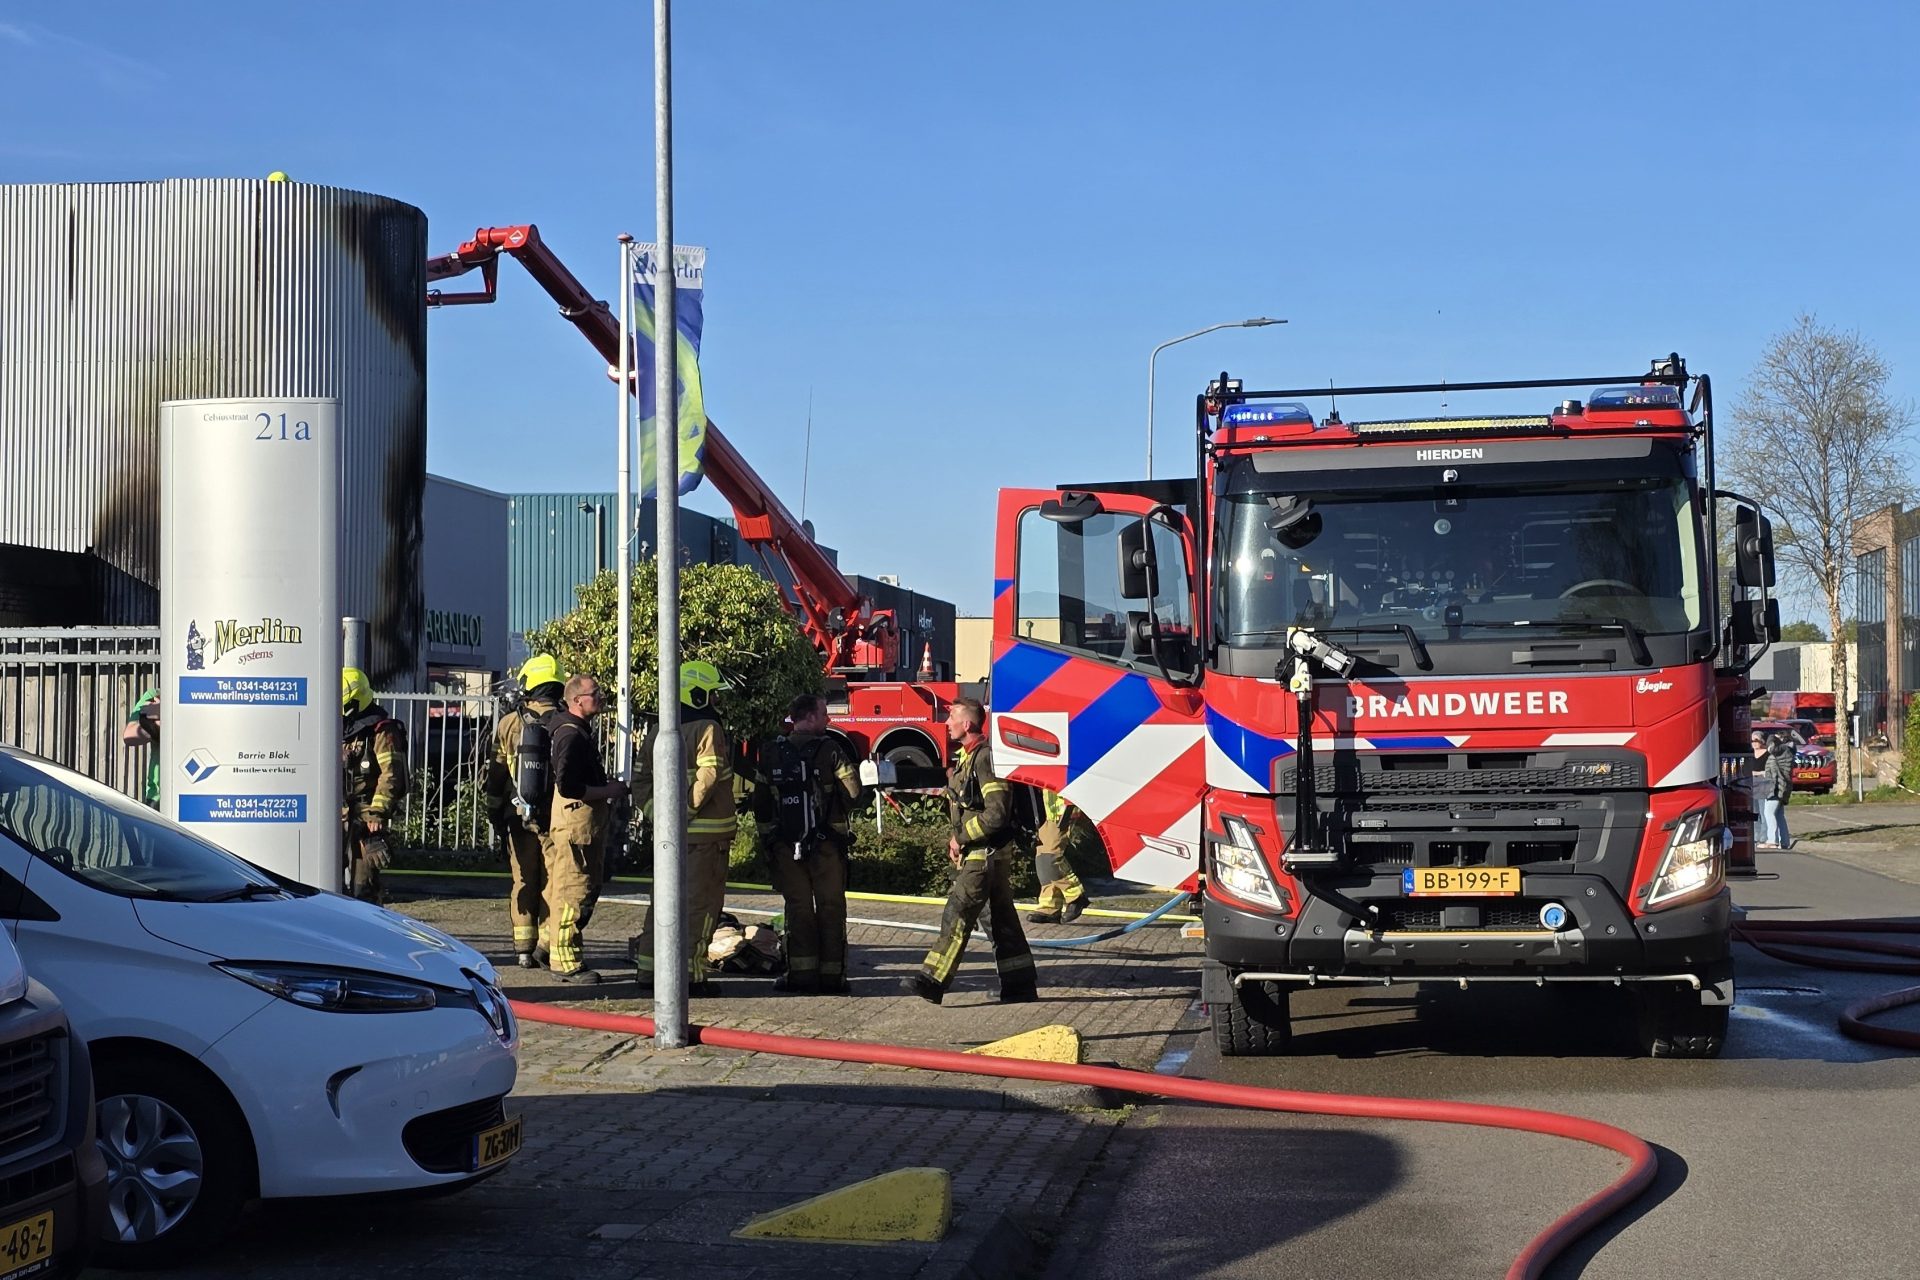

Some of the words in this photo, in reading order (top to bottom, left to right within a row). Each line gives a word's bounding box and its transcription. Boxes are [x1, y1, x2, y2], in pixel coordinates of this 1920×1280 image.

[255, 412, 312, 441] 21a
[1416, 448, 1483, 461] HIERDEN
[213, 618, 302, 664] Merlin
[238, 650, 274, 665] systems
[217, 680, 234, 691] Tel.
[235, 681, 298, 691] 0341-841231
[190, 690, 298, 702] www.merlinsystems.nl
[1346, 691, 1569, 718] BRANDWEER
[238, 751, 266, 760] Barrie
[269, 750, 290, 759] Blok
[232, 766, 297, 774] Houtbewerking
[216, 798, 233, 808] Tel.
[235, 798, 298, 808] 0341-472279
[209, 809, 298, 819] www.barrieblok.nl
[1424, 872, 1510, 889] BB-199-F
